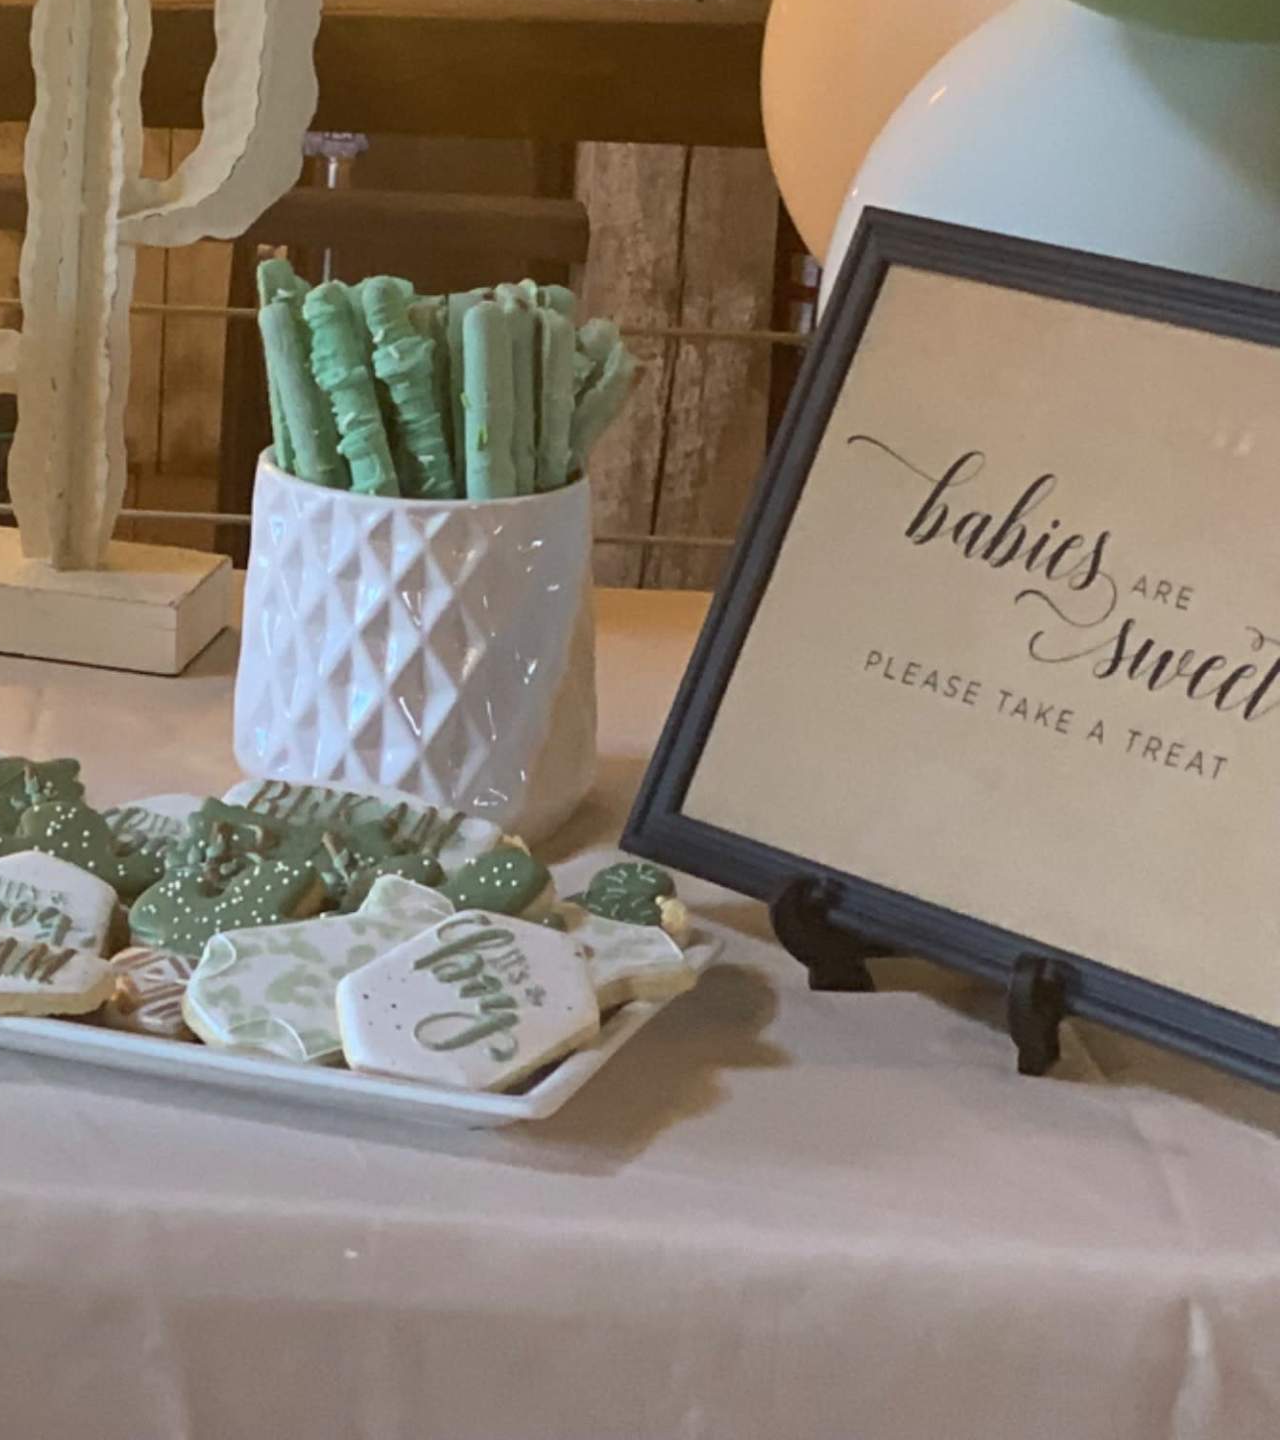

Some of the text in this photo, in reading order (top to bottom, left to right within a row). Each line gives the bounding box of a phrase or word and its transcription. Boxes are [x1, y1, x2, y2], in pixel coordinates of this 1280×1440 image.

[848, 434, 1195, 628] babies ARE
[864, 649, 1228, 781] PLEASE TAKE A TREAT
